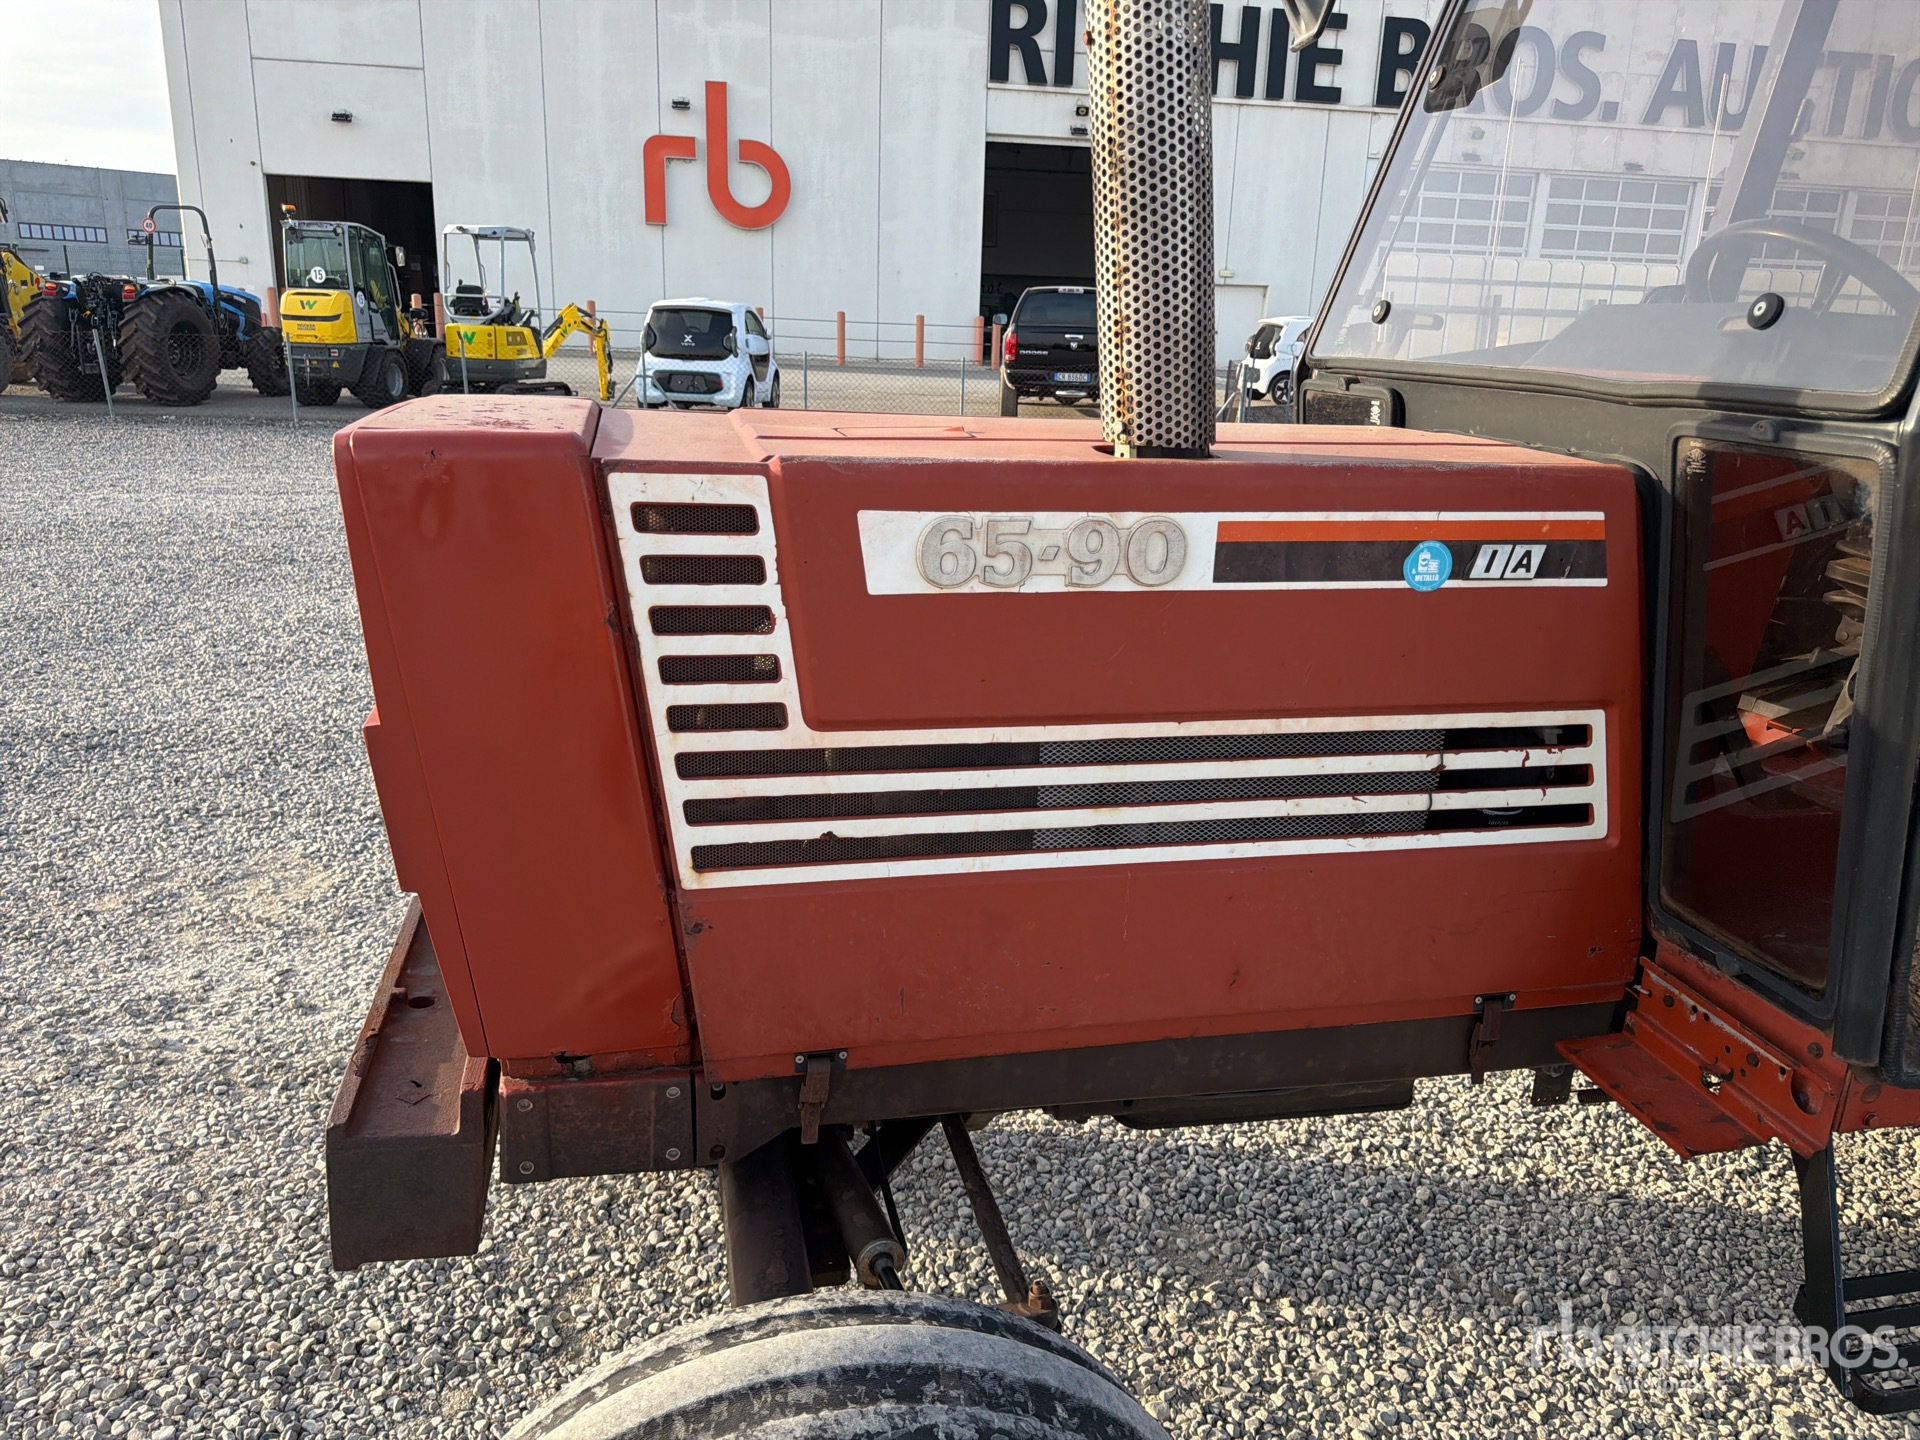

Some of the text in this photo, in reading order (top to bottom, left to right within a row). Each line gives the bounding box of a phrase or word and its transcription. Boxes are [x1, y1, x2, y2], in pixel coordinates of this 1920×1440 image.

[989, 0, 1349, 103] RIHIE
[1376, 15, 1619, 122] BROS.
[643, 80, 791, 230] rb
[145, 222, 153, 230] 40
[313, 269, 323, 281] 15
[917, 515, 1188, 589] 65-90
[1414, 574, 1440, 582] METALLO
